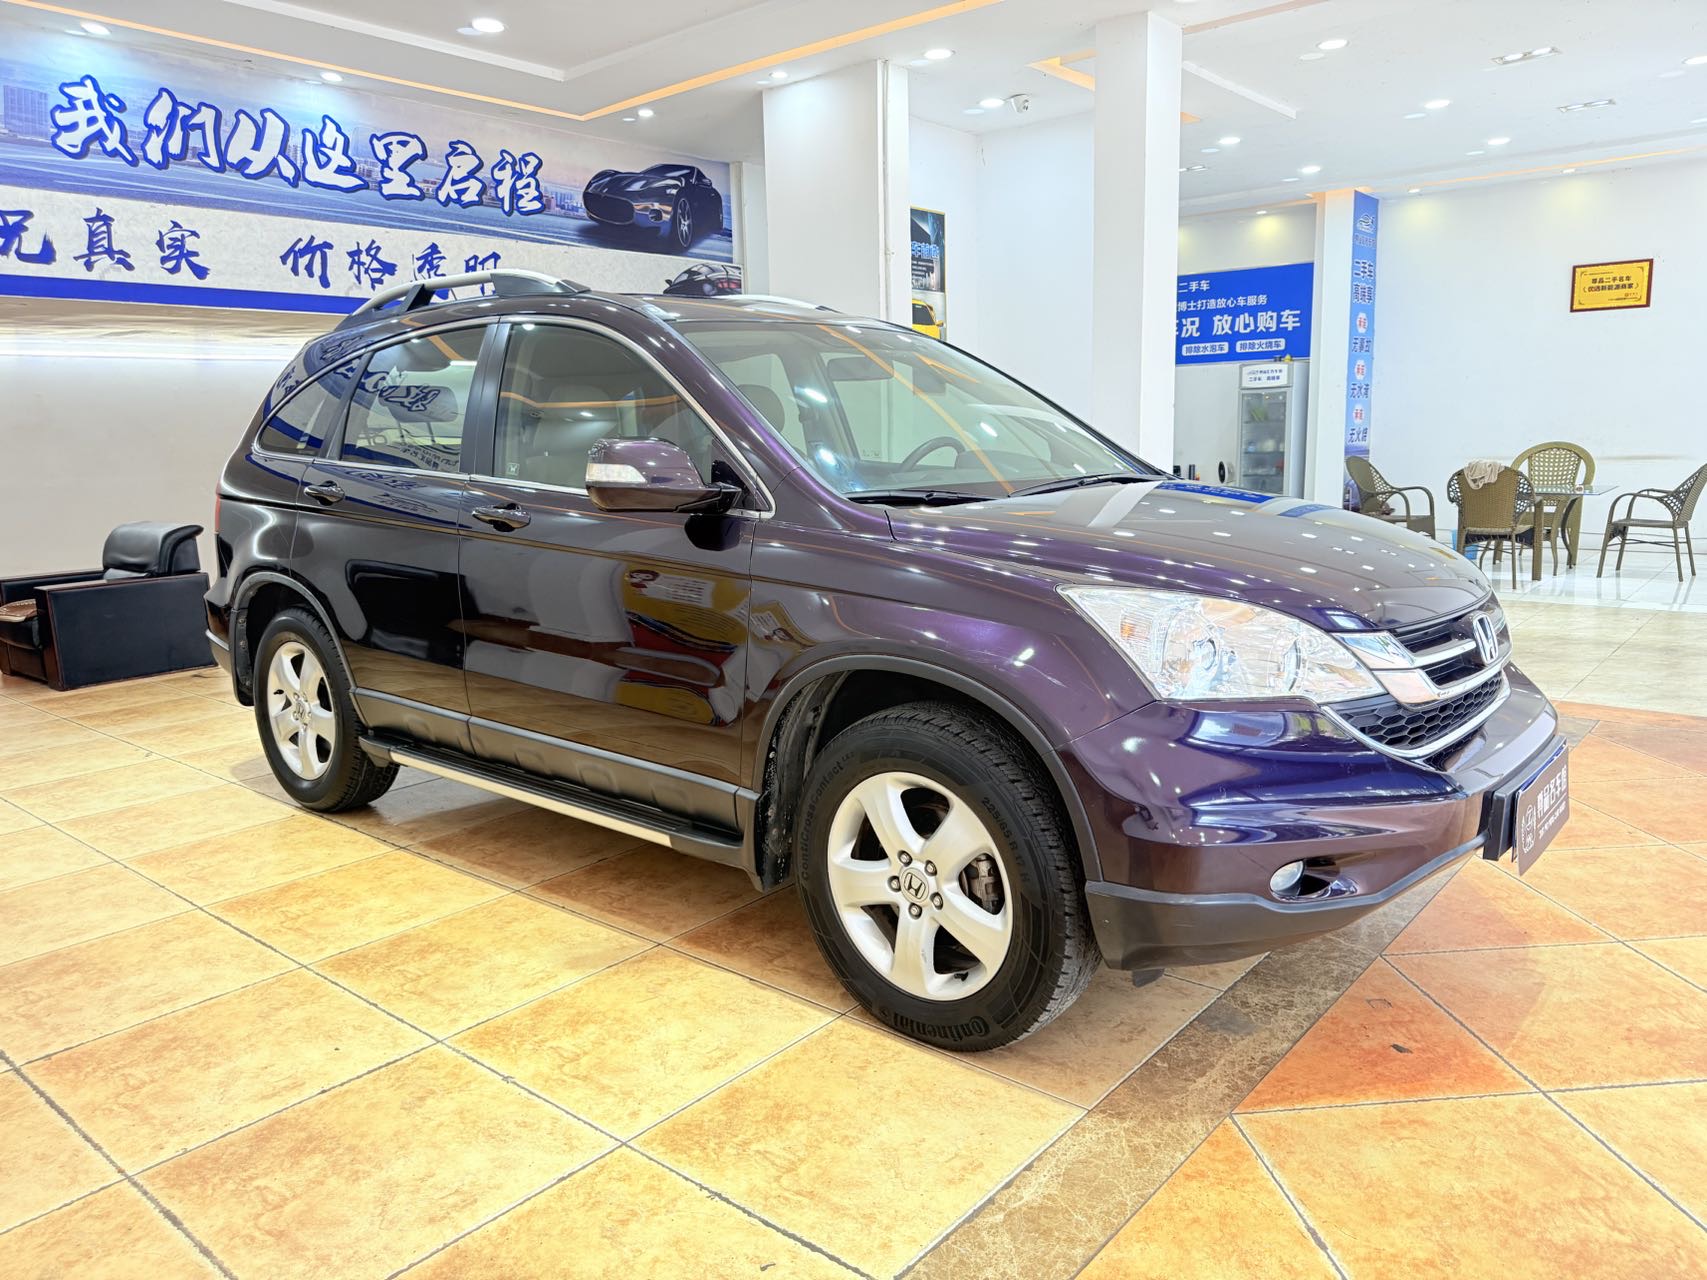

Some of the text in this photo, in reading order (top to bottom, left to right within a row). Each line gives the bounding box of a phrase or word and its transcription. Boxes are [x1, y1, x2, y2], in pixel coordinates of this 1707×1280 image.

[50, 74, 548, 217] 我们从这里启程
[1178, 280, 1210, 292] 二手车
[1212, 309, 1301, 337] 放心购车
